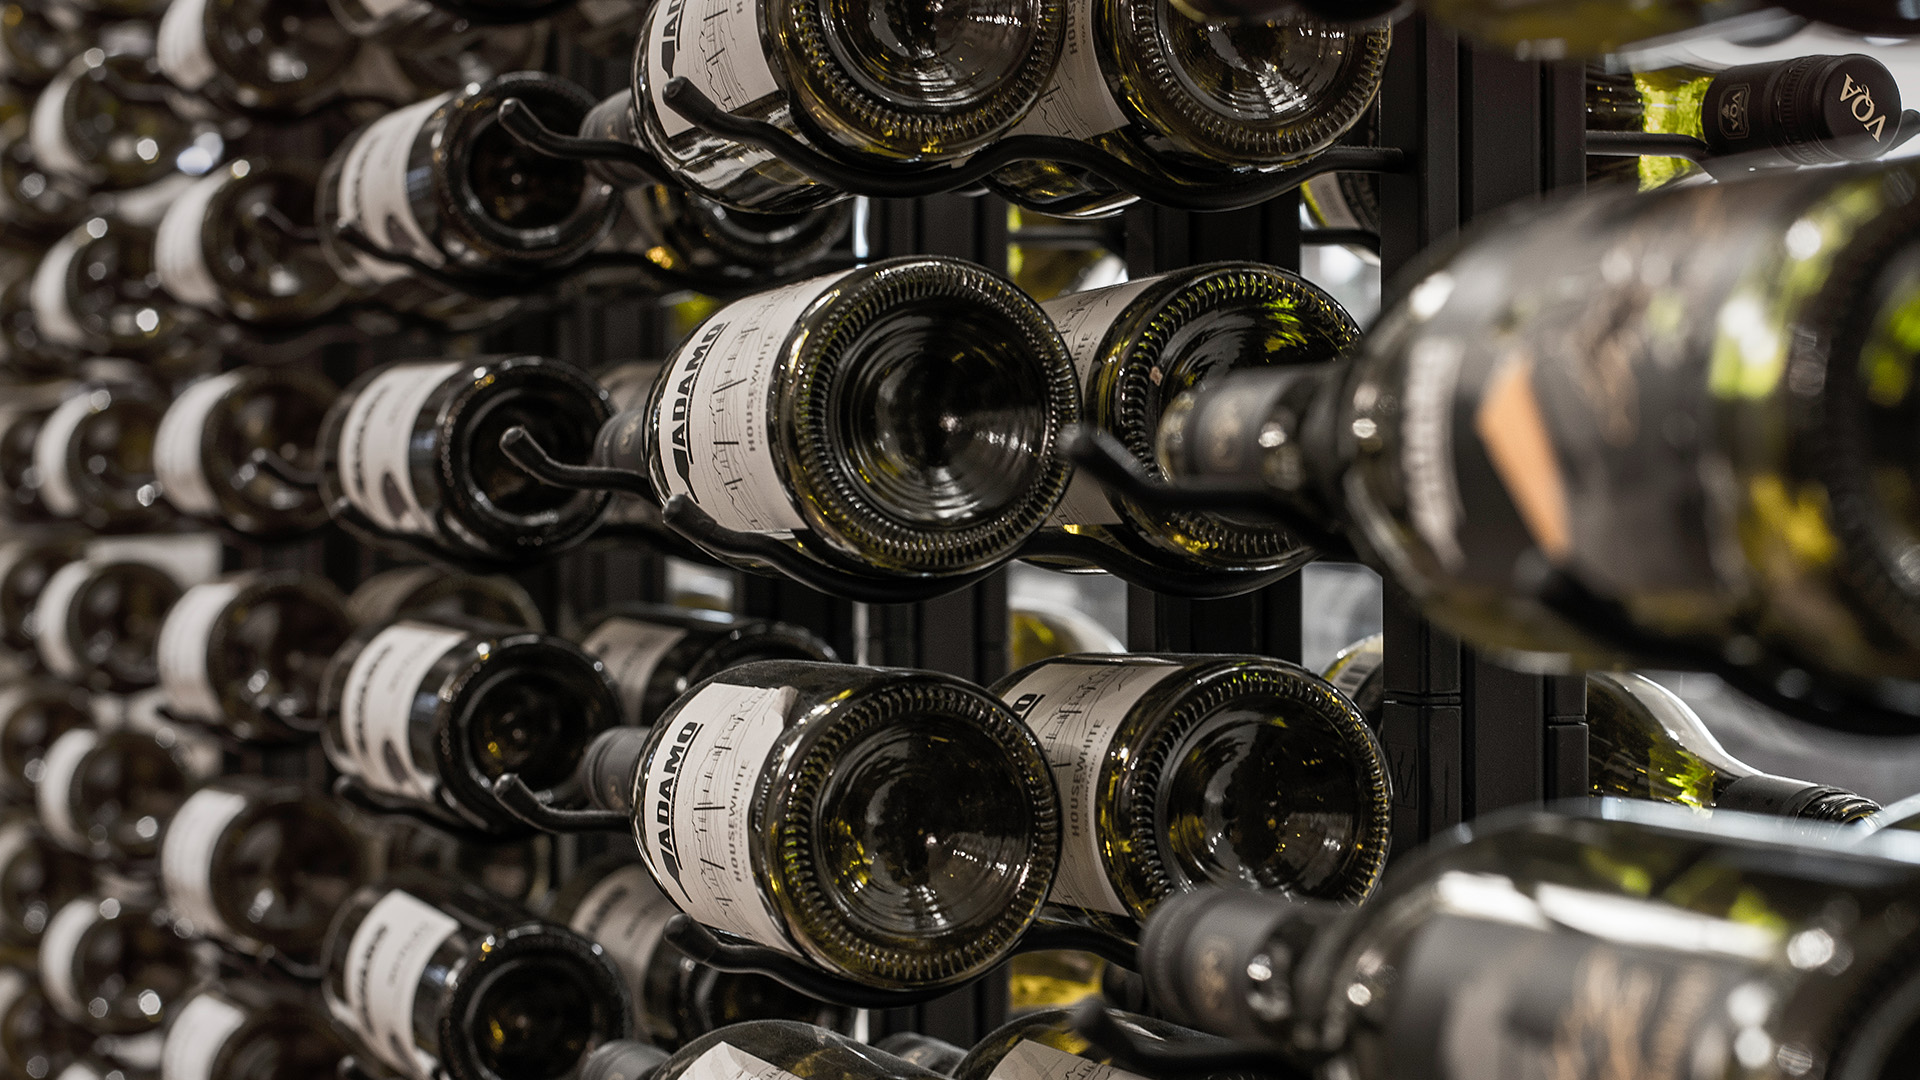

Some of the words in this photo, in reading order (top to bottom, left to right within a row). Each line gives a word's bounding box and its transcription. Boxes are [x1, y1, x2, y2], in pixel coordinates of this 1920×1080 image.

[1839, 73, 1887, 142] VQA
[672, 323, 725, 448] ADAMO
[657, 721, 698, 852] ADAMO
[728, 759, 750, 882] HOUSEWHITE
[1069, 719, 1105, 837] HOUSEWHITE
